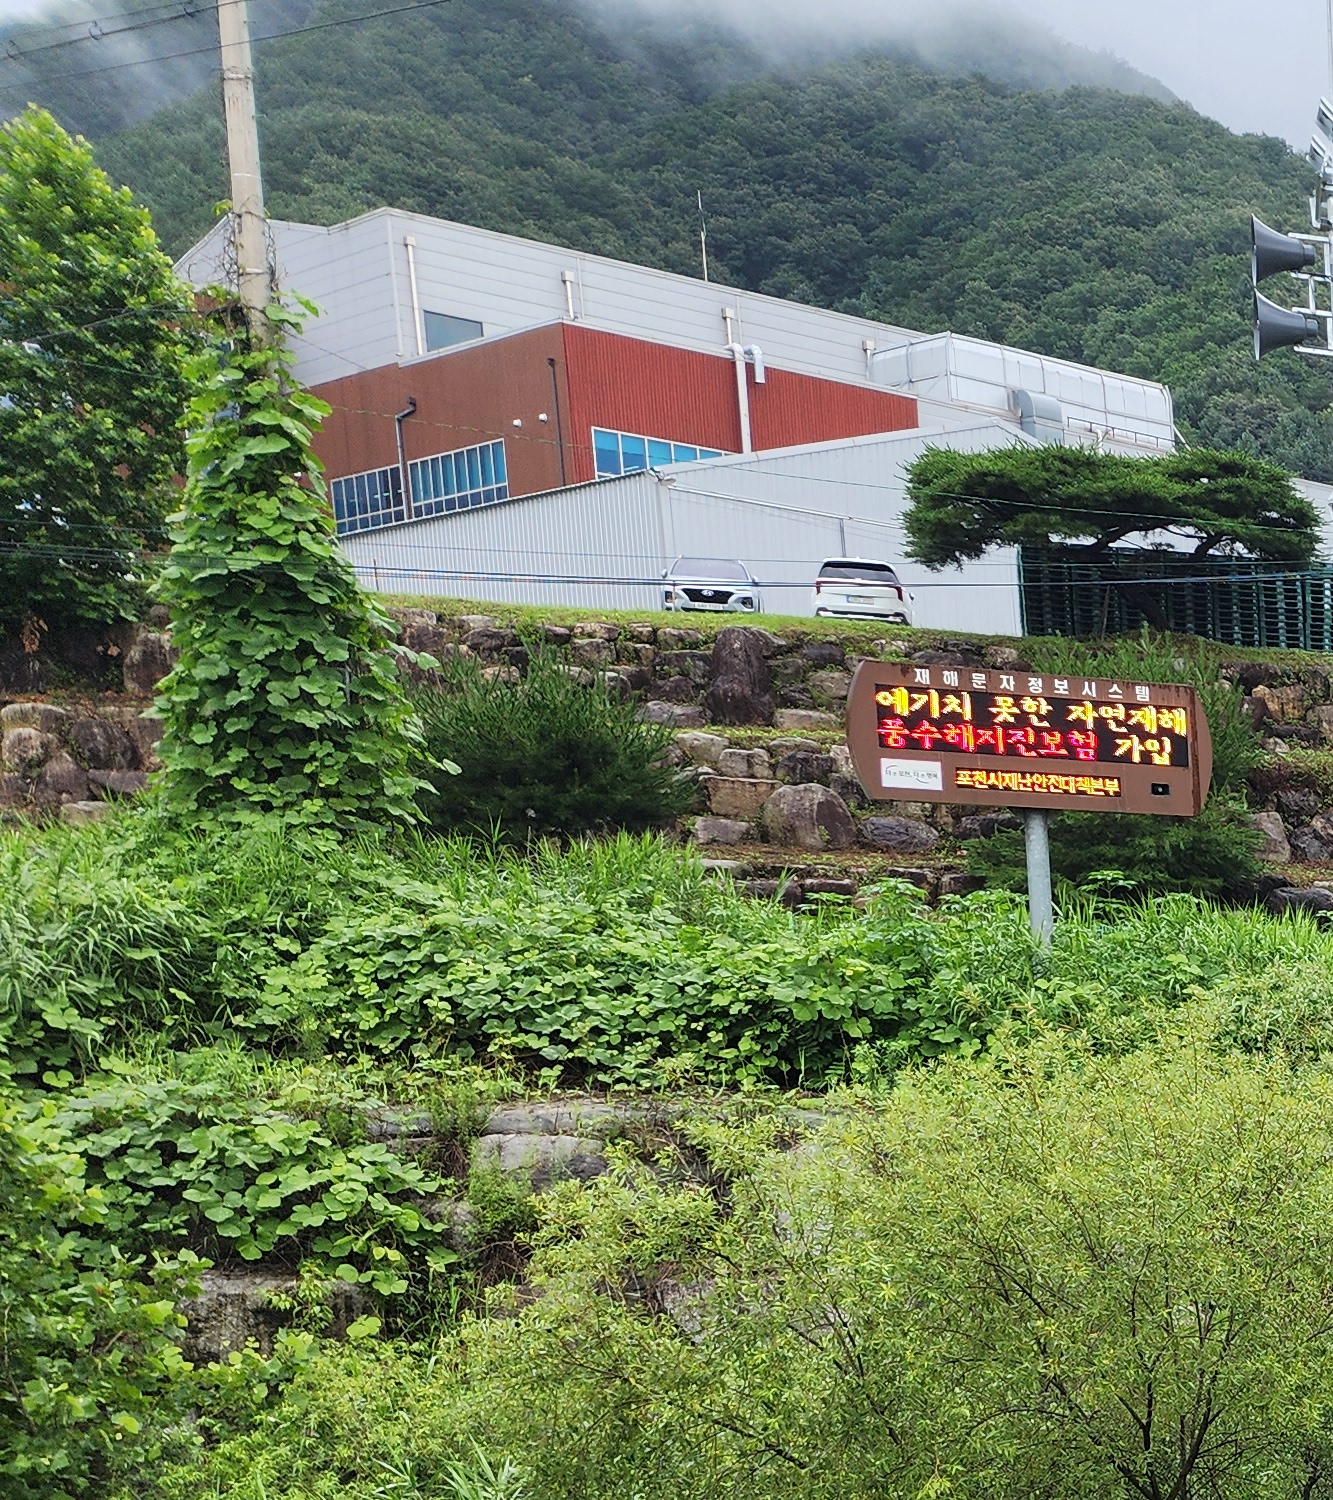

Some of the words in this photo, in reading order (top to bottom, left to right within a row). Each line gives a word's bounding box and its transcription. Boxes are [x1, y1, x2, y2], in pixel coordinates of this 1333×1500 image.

[914, 668, 1150, 702] 재해문자정보시스템
[875, 686, 972, 721] 예기치
[987, 694, 1053, 728] 못한
[1065, 700, 1187, 737] 자연재해
[876, 717, 1098, 762] 풍수해지진보험
[1112, 734, 1173, 766] 가입
[954, 769, 1120, 797] 포천시재난안전대책본부
